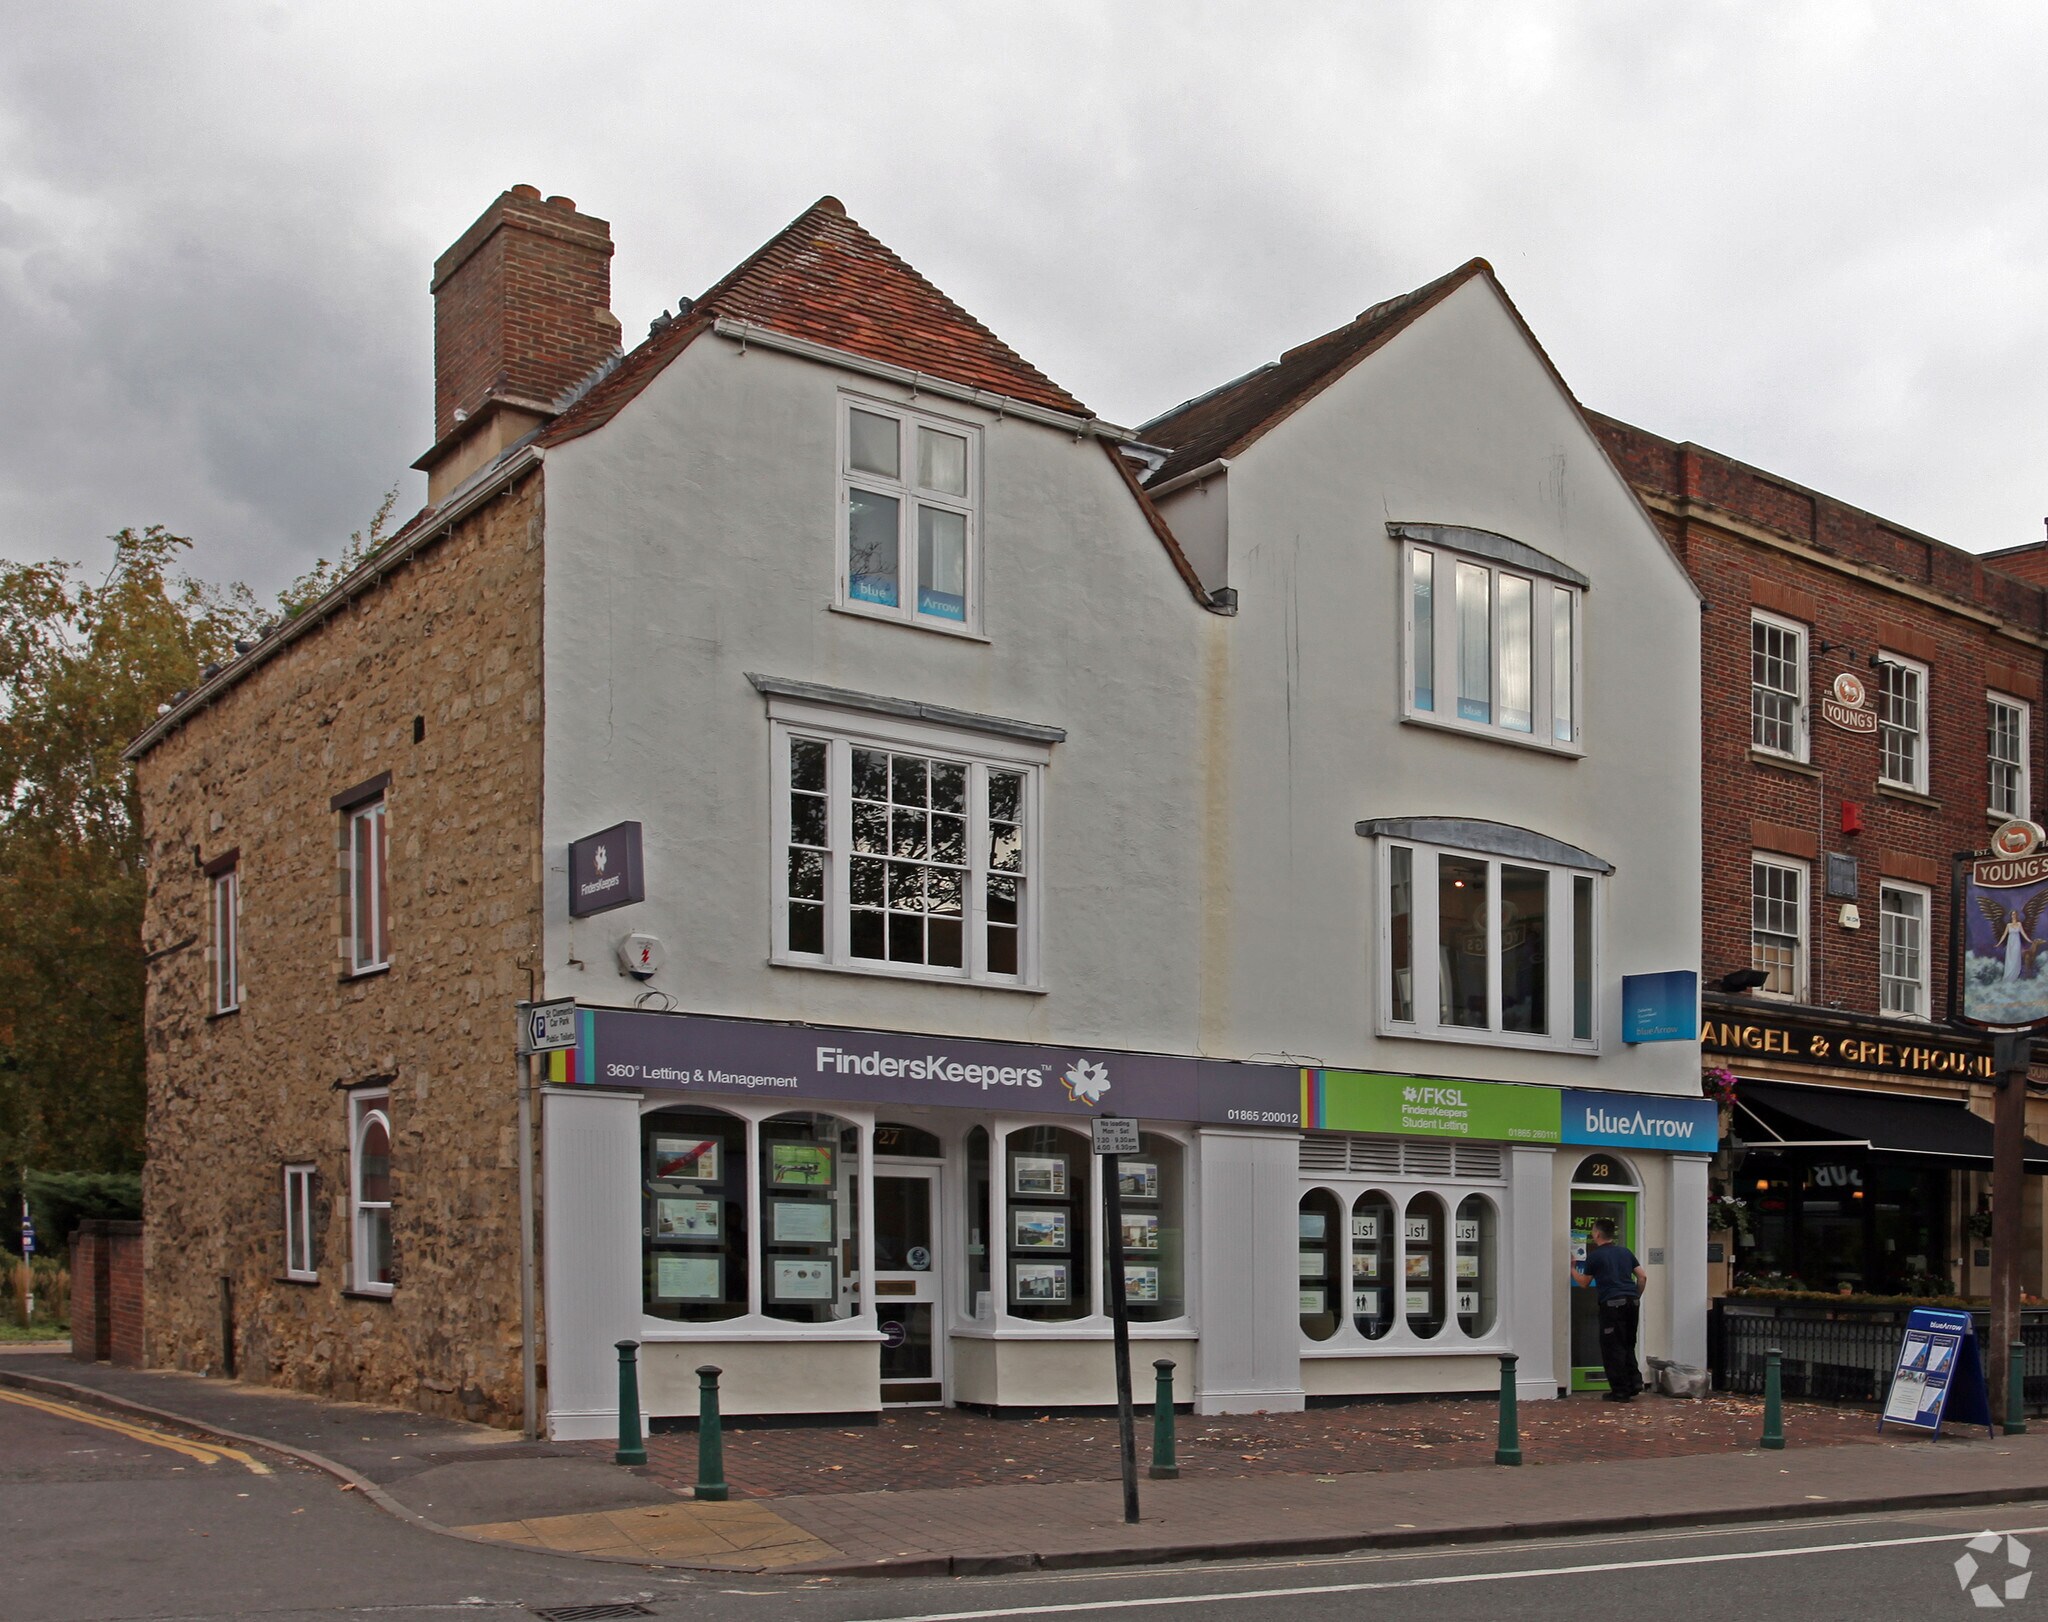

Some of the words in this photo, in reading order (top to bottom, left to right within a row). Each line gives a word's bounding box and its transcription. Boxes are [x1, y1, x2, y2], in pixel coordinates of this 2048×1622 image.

[860, 583, 886, 598] blue
[923, 597, 960, 613] Arrow
[1827, 704, 1873, 728] YOUNG'S
[1700, 1020, 1799, 1055] ANGEL
[1809, 1034, 1830, 1057] &
[642, 1065, 691, 1085] Letting
[692, 1069, 705, 1083] &
[707, 1070, 798, 1089] Management
[1227, 1109, 1260, 1121] 01865
[1261, 1111, 1299, 1124] 200012
[1401, 1104, 1468, 1119] FindersKeepers
[1402, 1116, 1437, 1129] Student
[1438, 1119, 1468, 1134] Letting
[1585, 1107, 1694, 1138] blueArrow
[878, 1129, 899, 1145] 27
[1592, 1163, 1609, 1177] 28
